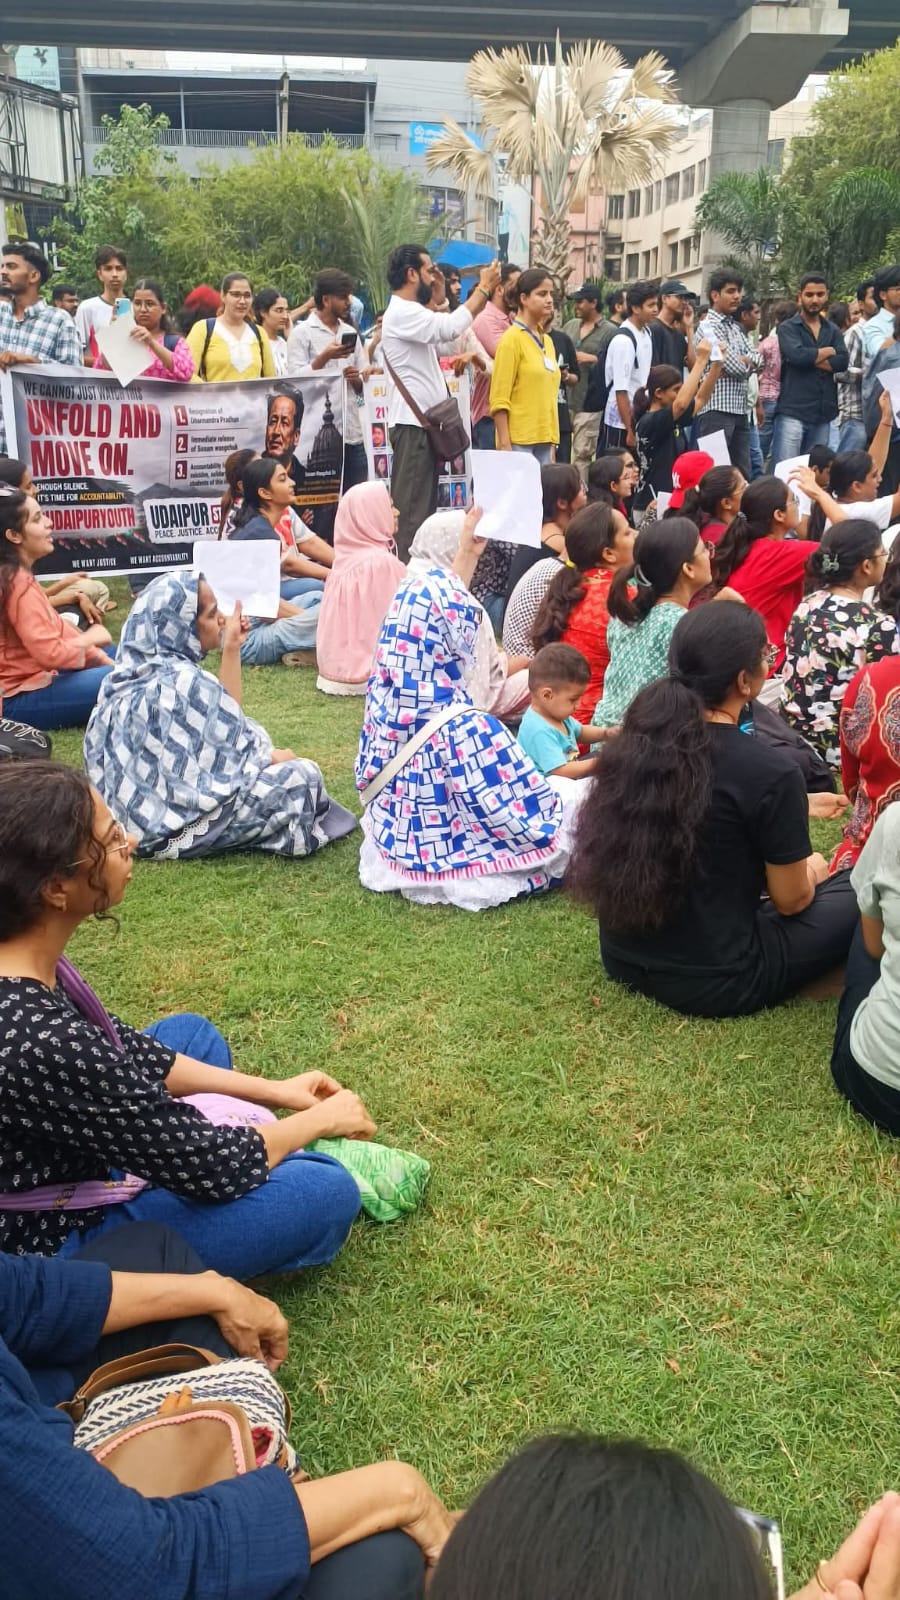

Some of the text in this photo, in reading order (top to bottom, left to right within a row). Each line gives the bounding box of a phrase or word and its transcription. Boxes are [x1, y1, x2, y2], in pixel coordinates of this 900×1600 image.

[24, 381, 38, 396] WE
[39, 384, 75, 399] CANNOT
[77, 385, 98, 400] JUST
[98, 387, 124, 401] WATCH
[26, 399, 162, 438] UNFOLD AND
[375, 406, 385, 419] 21
[177, 436, 187, 452] 2.
[30, 440, 134, 477] MOVE ON.
[176, 463, 186, 478] 3.
[36, 482, 63, 491] ENOUGH
[37, 494, 50, 502] IT'S
[50, 493, 66, 501] TIME
[66, 493, 78, 501] FOR
[43, 507, 136, 531] UDAIPURYOUTH
[150, 502, 210, 529] UDAIPUR
[205, 526, 219, 535] ACC
[72, 558, 117, 569] WE WANT JUSTICE
[130, 553, 189, 565] WE WANT ACCOUNTABILITY
